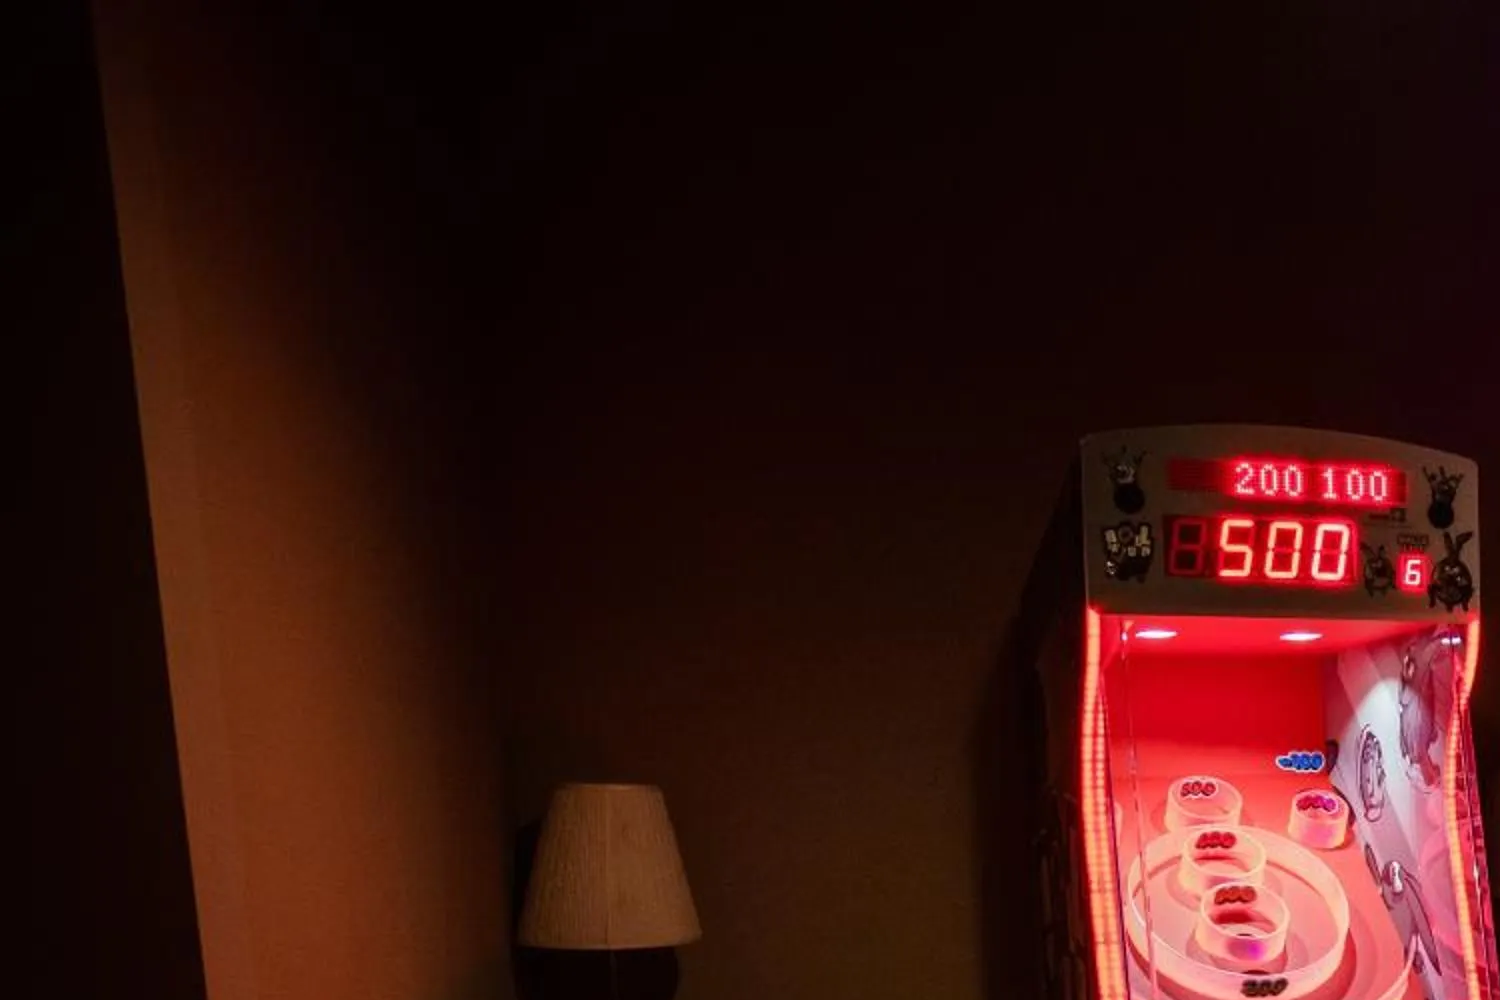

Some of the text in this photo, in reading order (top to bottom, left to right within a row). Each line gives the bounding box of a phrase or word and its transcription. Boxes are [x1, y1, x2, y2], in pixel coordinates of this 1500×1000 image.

[1234, 462, 1388, 501] 200 100
[1218, 517, 1350, 582] 500
[1404, 558, 1422, 586] 6
